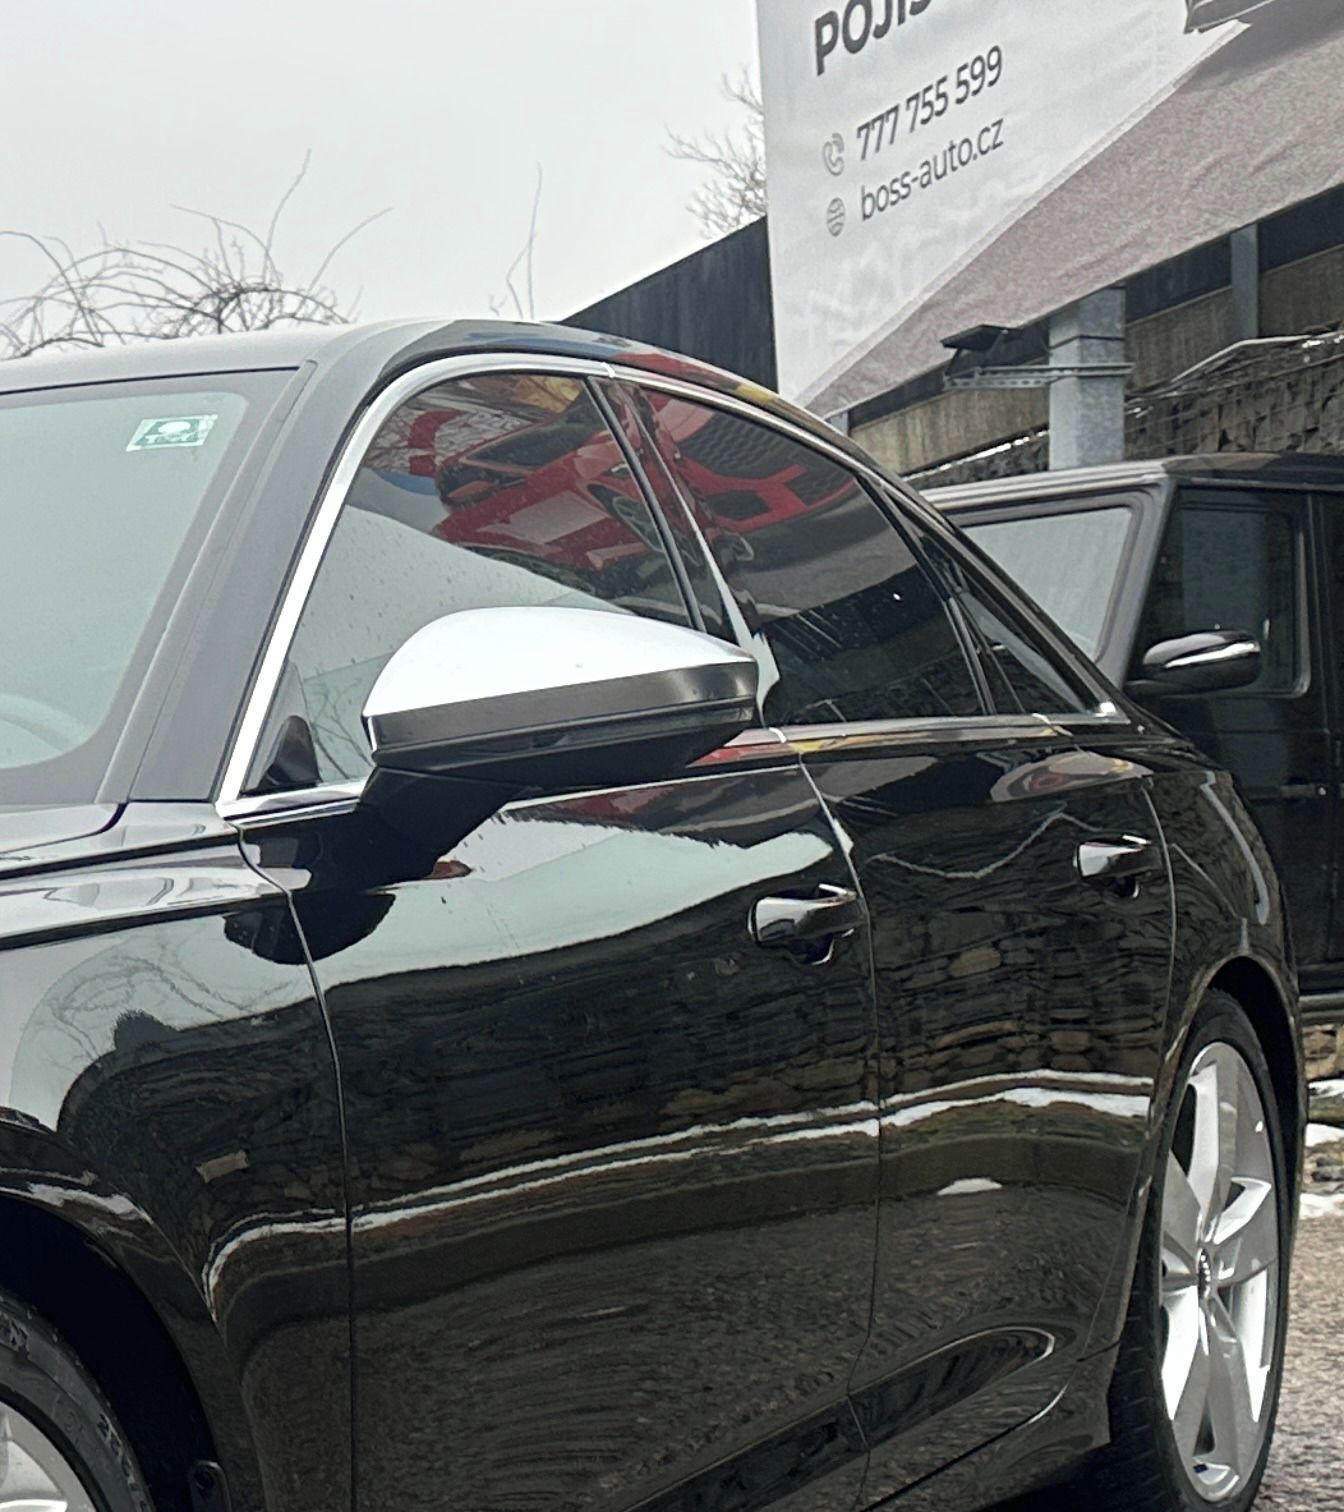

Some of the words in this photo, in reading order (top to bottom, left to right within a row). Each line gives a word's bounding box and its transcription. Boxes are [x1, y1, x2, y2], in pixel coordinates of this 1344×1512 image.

[815, 0, 933, 77] POJ
[857, 103, 900, 161] 777
[906, 75, 948, 133] 755
[955, 45, 1002, 105] 599
[861, 118, 1004, 221] boss-auto.cz
